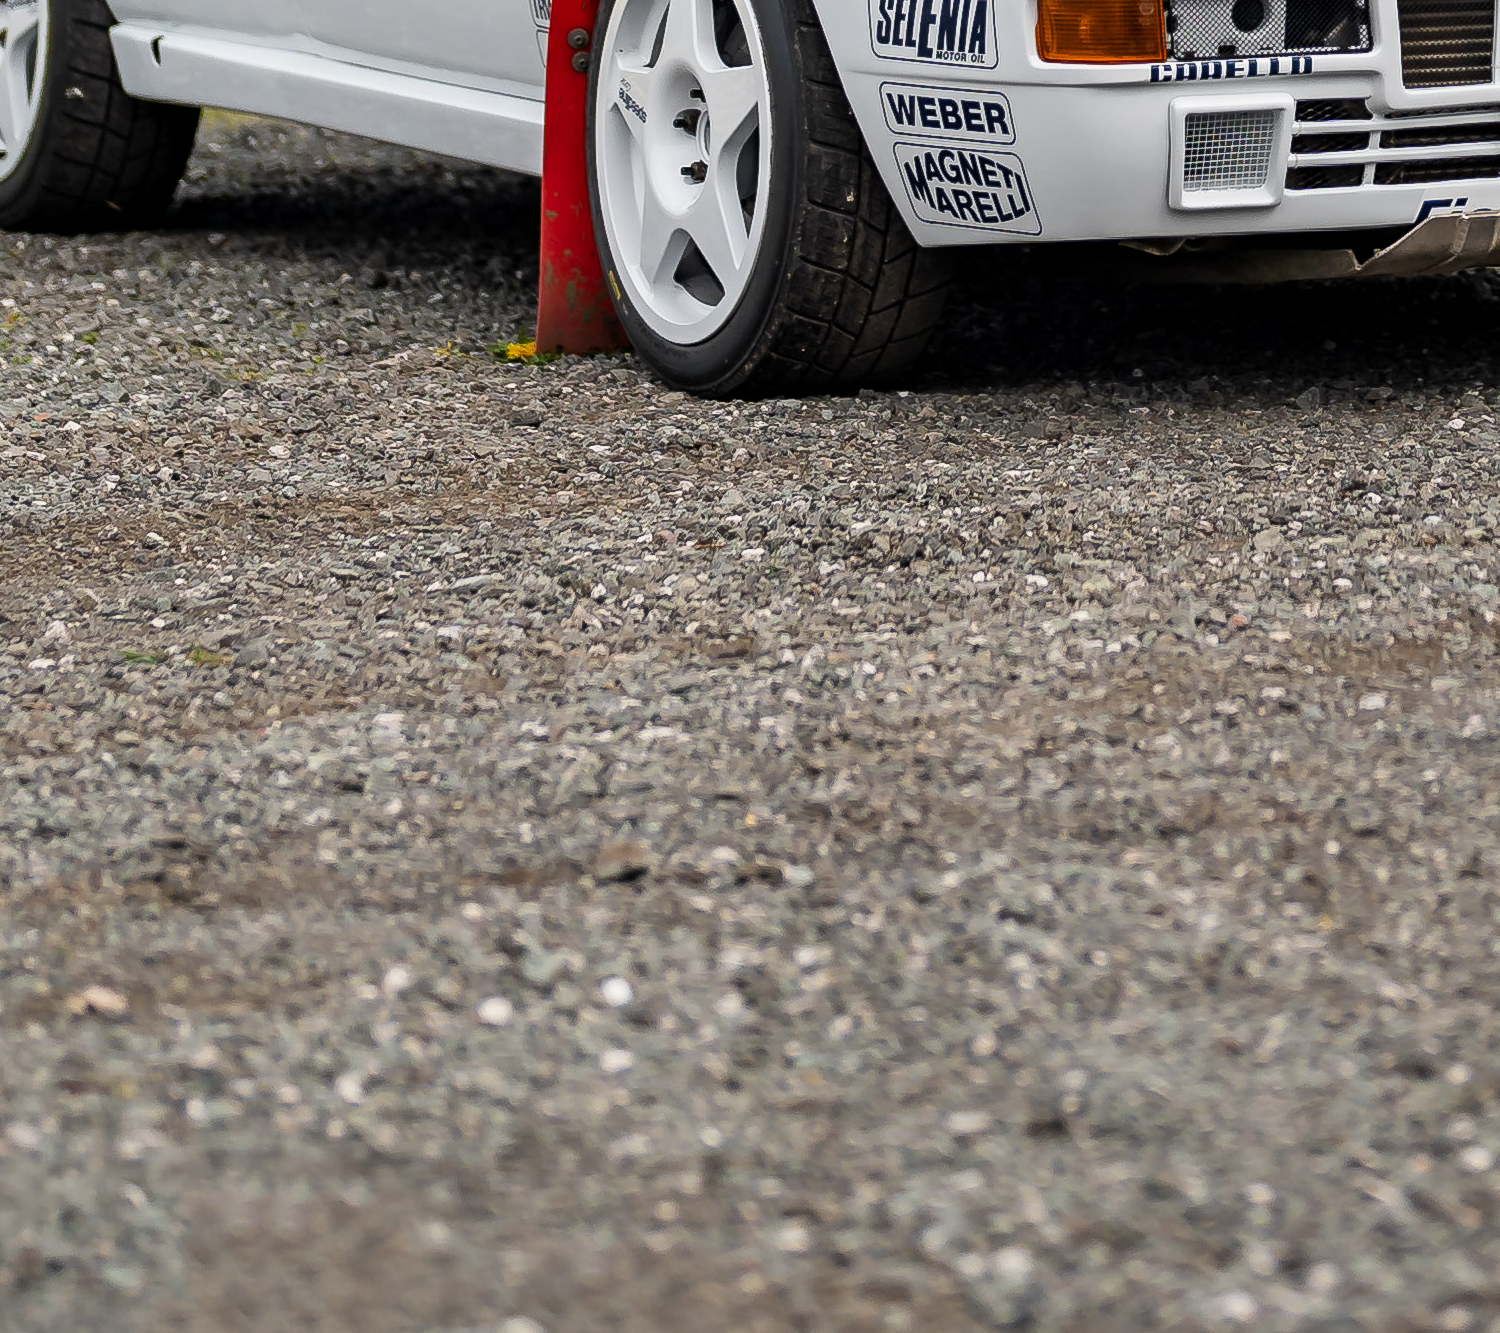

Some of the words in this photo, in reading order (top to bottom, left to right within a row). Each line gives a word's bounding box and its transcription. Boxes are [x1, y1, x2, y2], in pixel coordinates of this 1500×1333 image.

[936, 51, 968, 62] MOTOR
[971, 54, 986, 64] OIL
[886, 92, 1010, 135] WEBER
